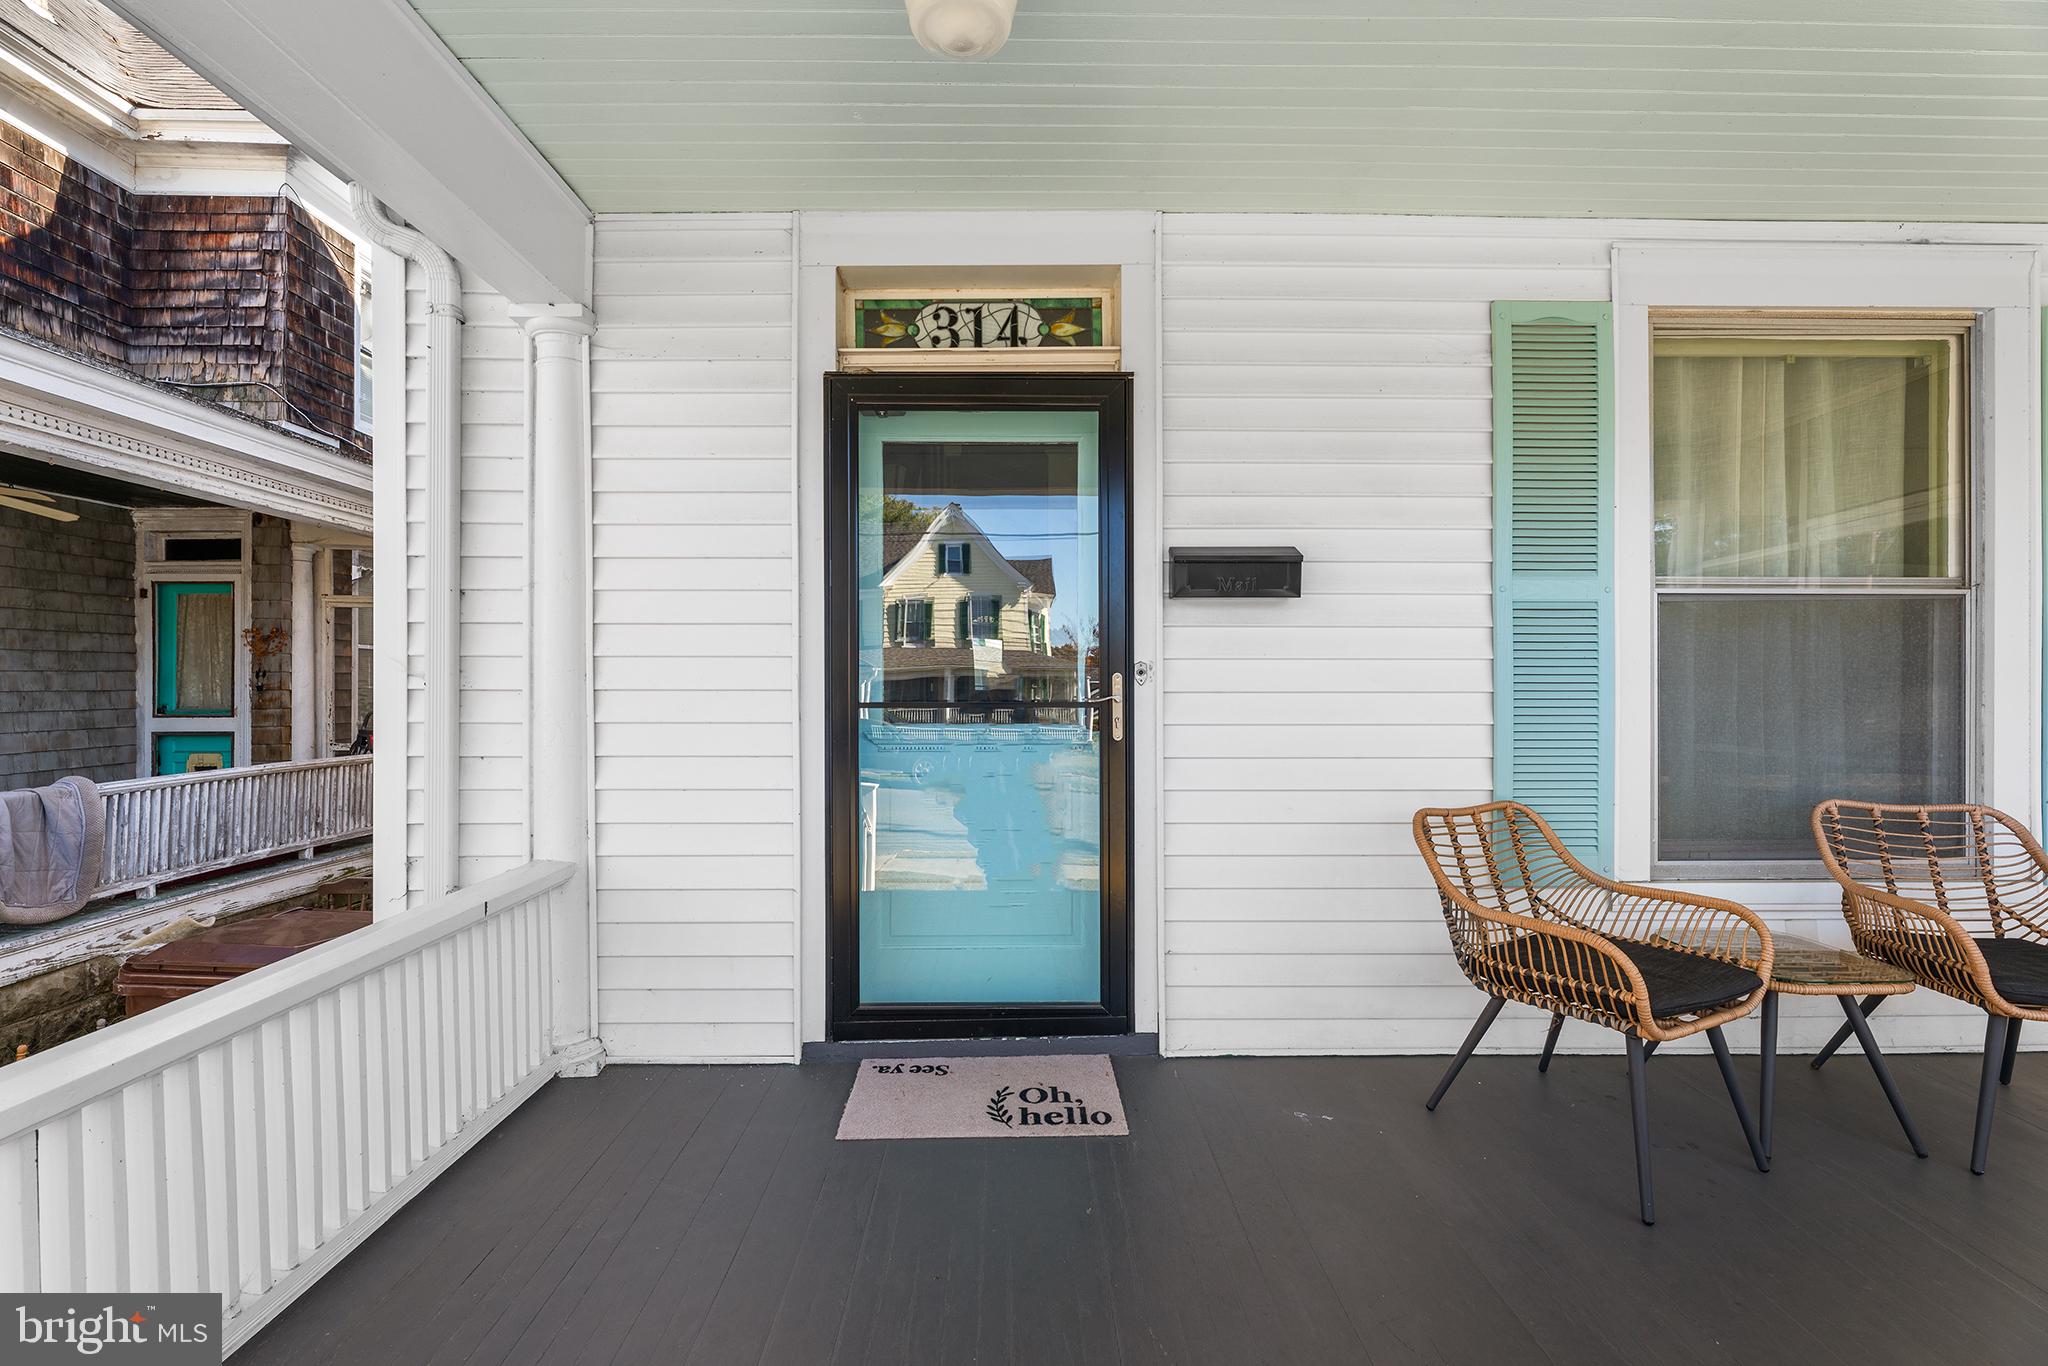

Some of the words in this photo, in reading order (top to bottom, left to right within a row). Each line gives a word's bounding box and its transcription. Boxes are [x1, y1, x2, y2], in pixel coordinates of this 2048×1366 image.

[932, 305, 1028, 347] 314
[1216, 576, 1258, 592] Mail
[909, 1064, 950, 1076] See
[1019, 1086, 1084, 1107] Oh,
[1018, 1106, 1113, 1126] hello
